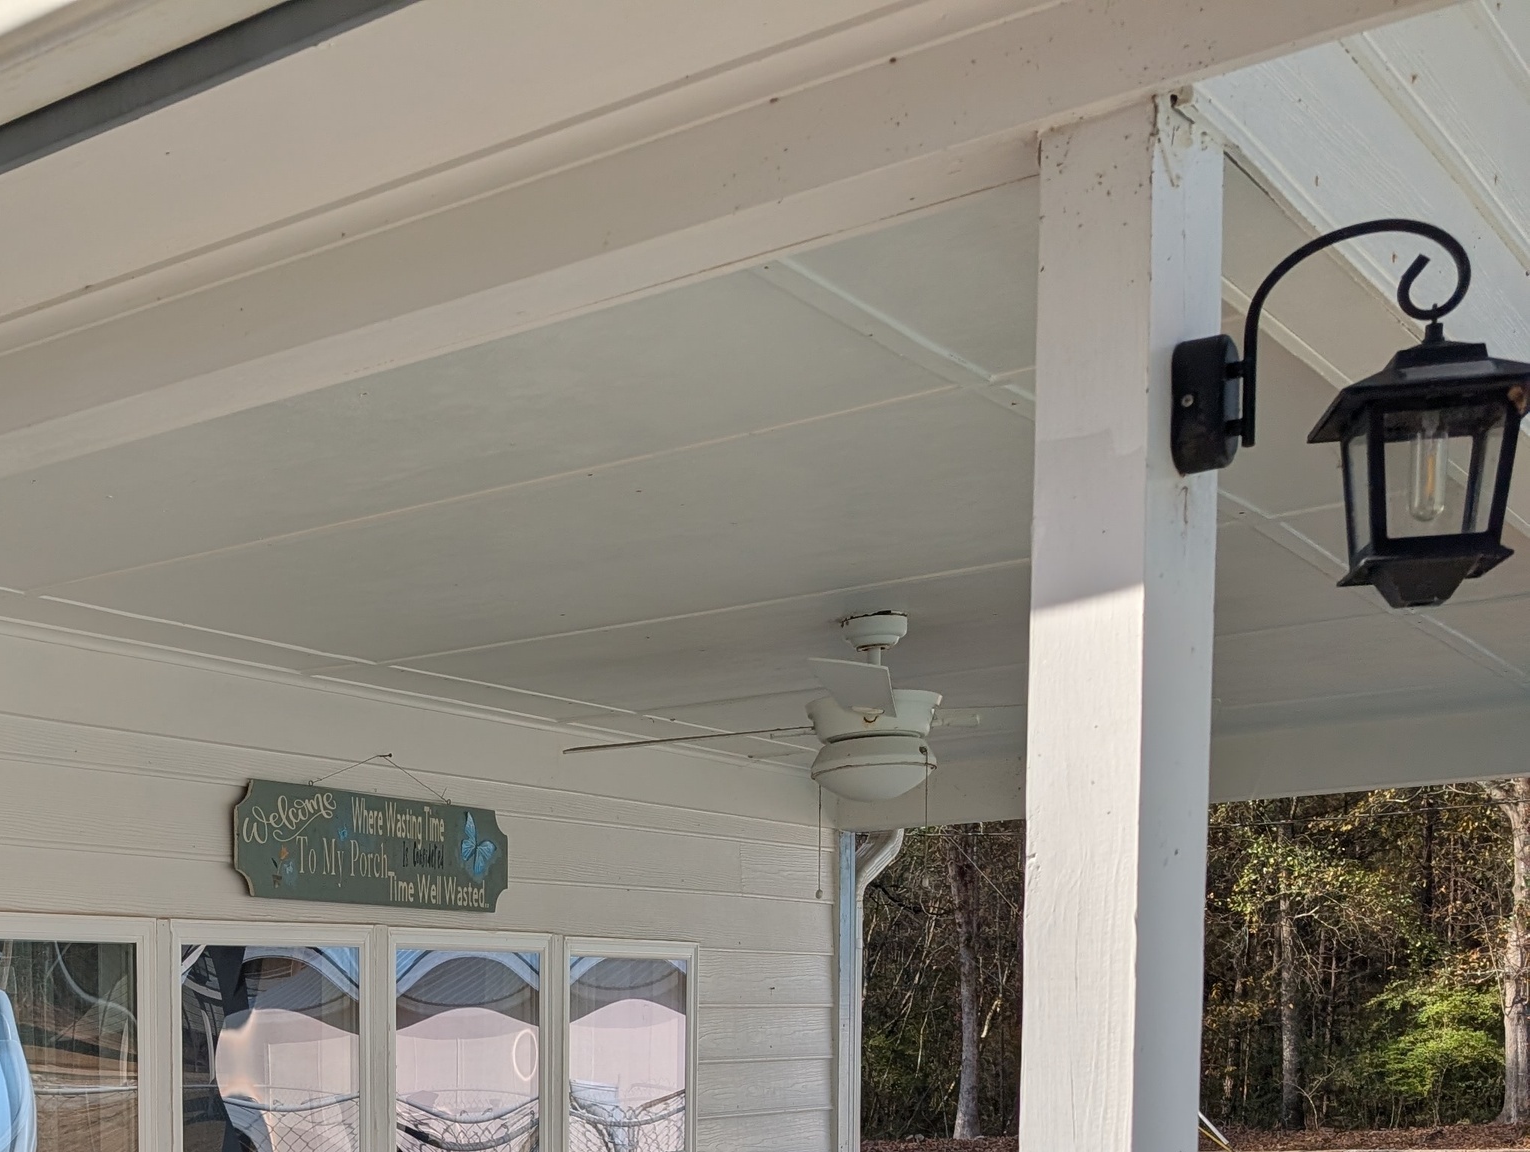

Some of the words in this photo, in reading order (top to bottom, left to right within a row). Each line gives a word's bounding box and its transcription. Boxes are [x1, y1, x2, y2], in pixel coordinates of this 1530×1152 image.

[243, 792, 337, 844] Welcome
[351, 796, 384, 837] Where
[385, 801, 423, 850] Wasting
[424, 806, 445, 842] Time
[296, 836, 317, 874] To
[323, 838, 344, 888] My
[350, 840, 388, 878] Porch
[388, 871, 415, 902] Time
[417, 874, 442, 904] Well
